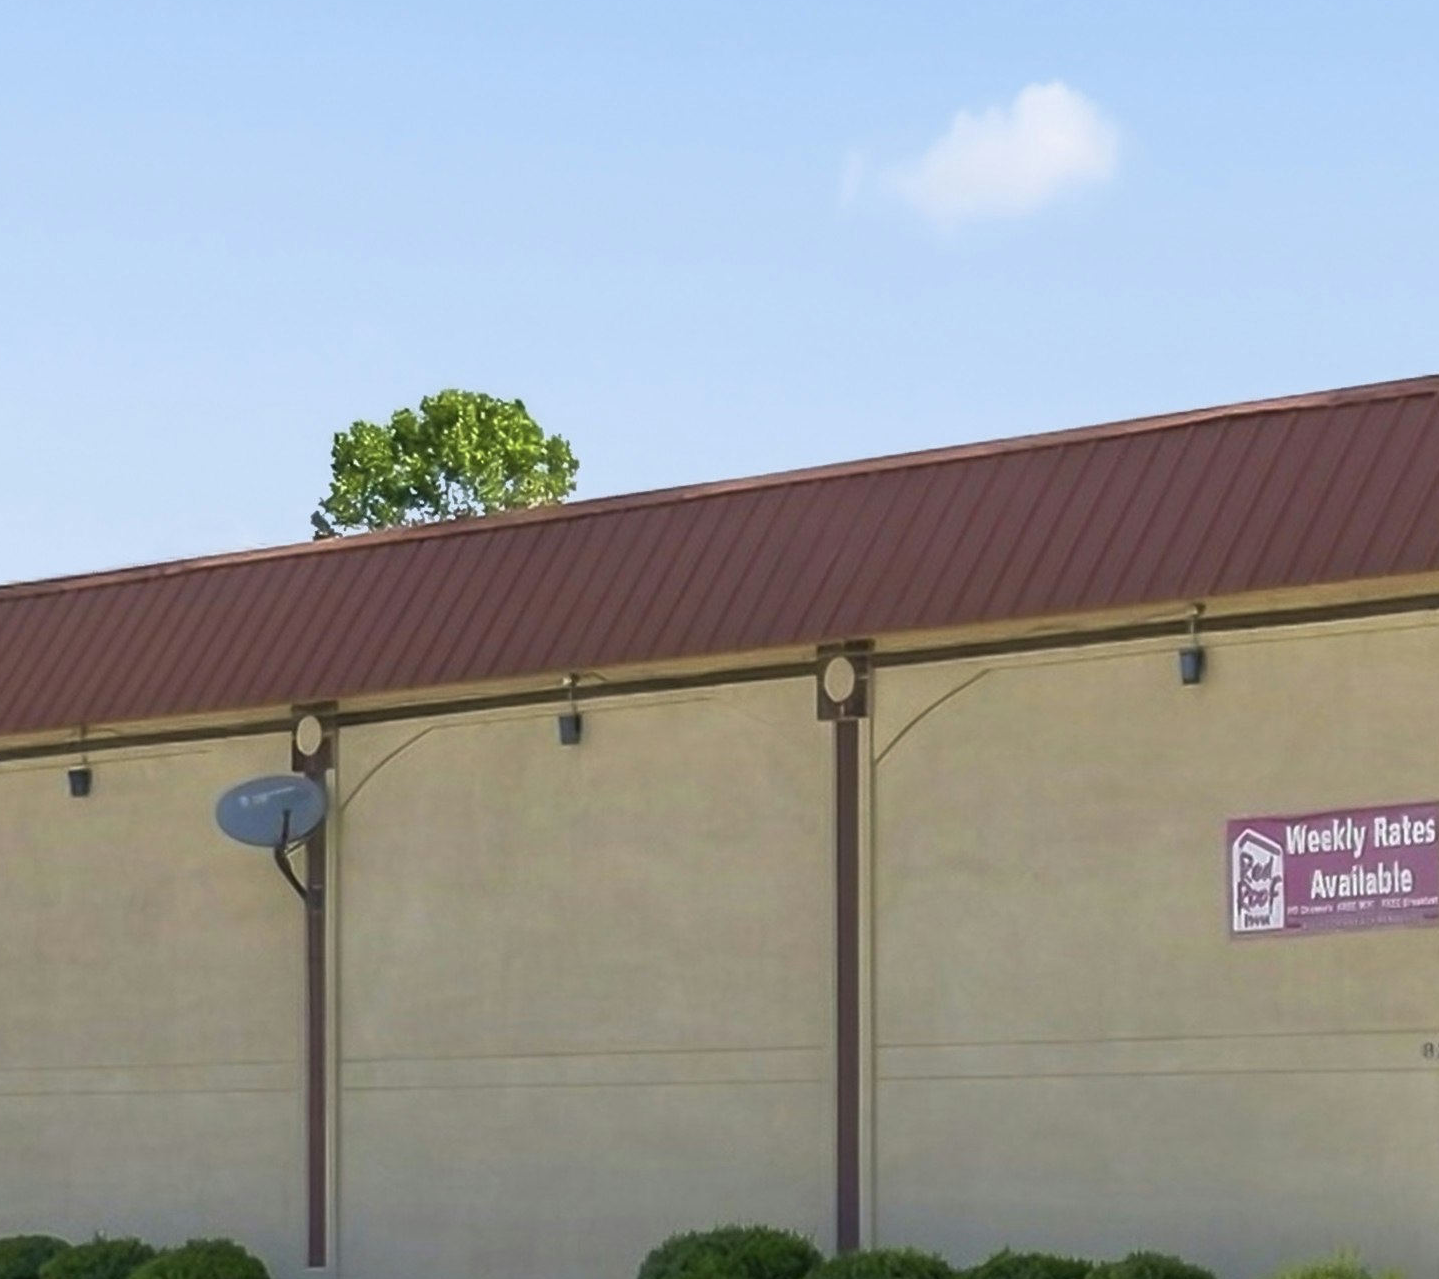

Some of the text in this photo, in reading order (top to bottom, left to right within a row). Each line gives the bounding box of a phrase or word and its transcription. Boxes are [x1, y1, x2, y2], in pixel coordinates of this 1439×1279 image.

[1286, 814, 1437, 859] Weekly Rates
[1239, 852, 1274, 884] Red
[1311, 861, 1414, 900] Available
[1237, 874, 1283, 916] Roof
